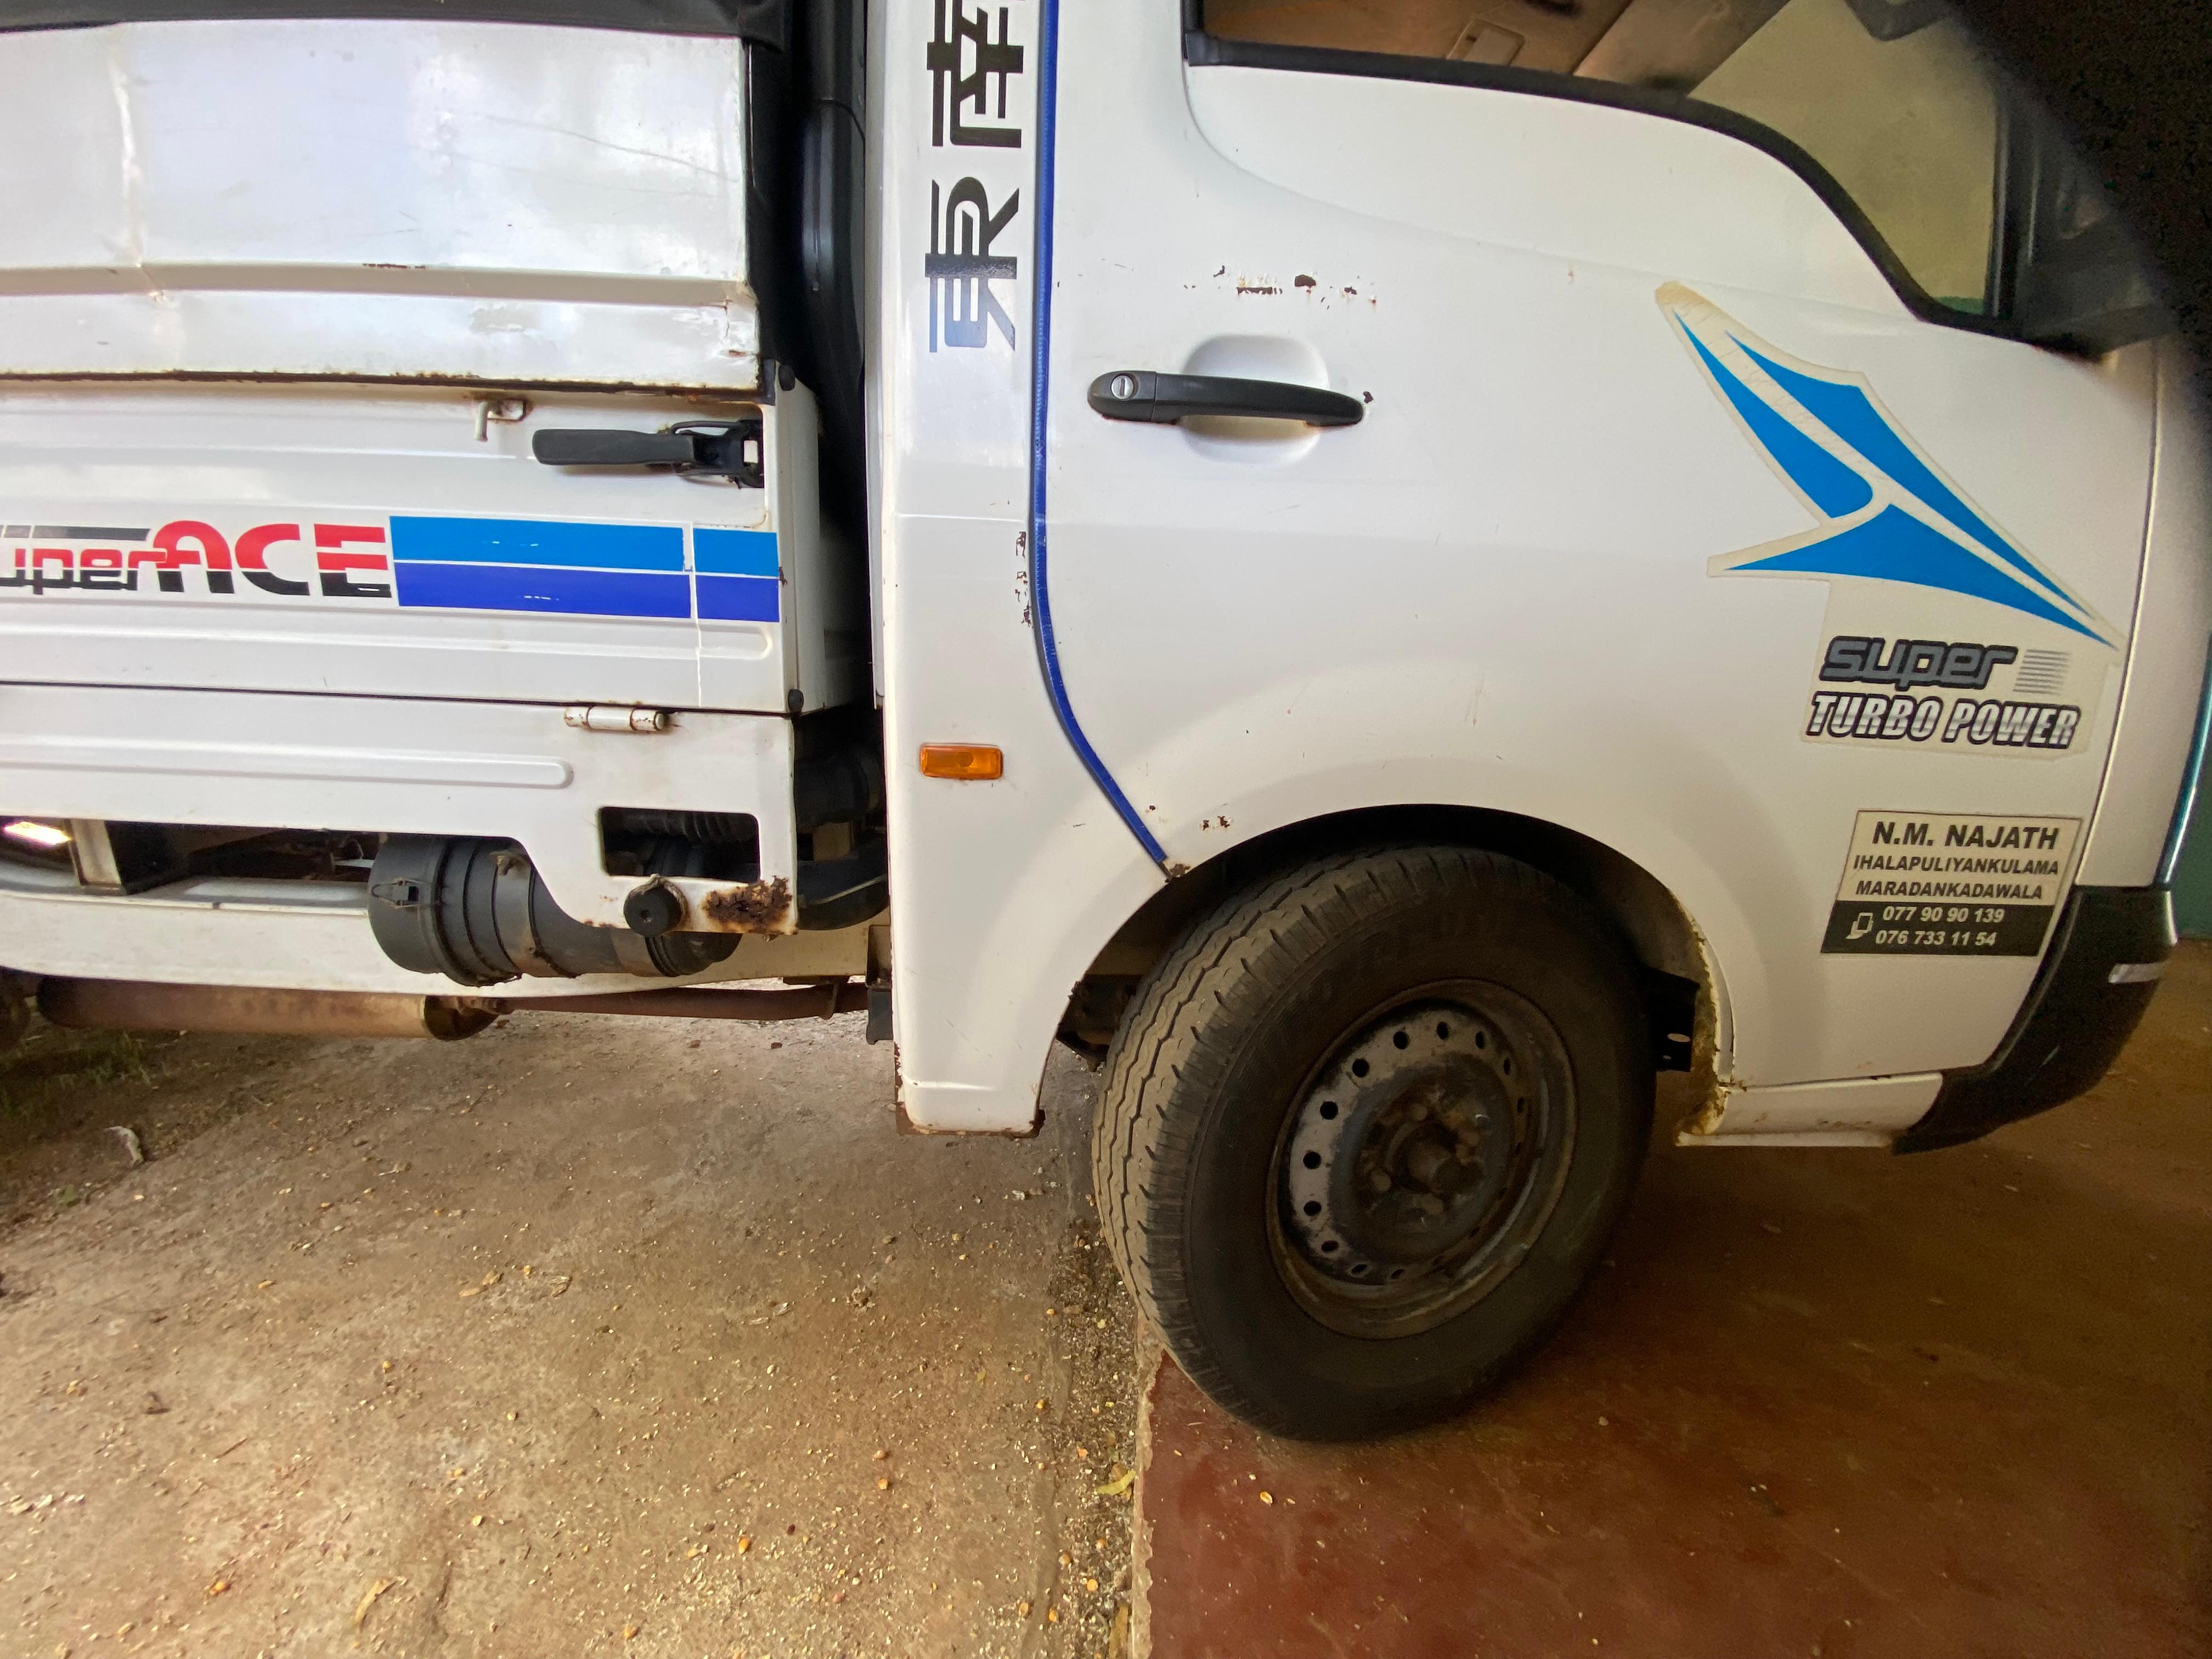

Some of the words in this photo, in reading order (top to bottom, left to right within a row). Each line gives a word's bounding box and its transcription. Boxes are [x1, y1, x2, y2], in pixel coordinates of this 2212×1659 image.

[153, 520, 392, 598] ACE
[1819, 636, 2018, 691] super
[1805, 691, 1944, 742] TURBO
[1941, 698, 2082, 749] POWER
[1872, 821, 1934, 847] N.M.
[1944, 825, 2059, 850] NAJATH
[1853, 855, 2059, 875] IHALAPULIYANKULAMA
[1855, 880, 2042, 900] MARADANKADAWALA
[1882, 906, 1917, 922] 077
[1920, 906, 1944, 922] 90
[1946, 907, 1970, 923] 90
[1975, 908, 2005, 923] 139
[1875, 930, 1909, 945] 076
[1914, 930, 1945, 945] 733
[1951, 932, 1971, 946] 11
[1974, 932, 1997, 946] 54
